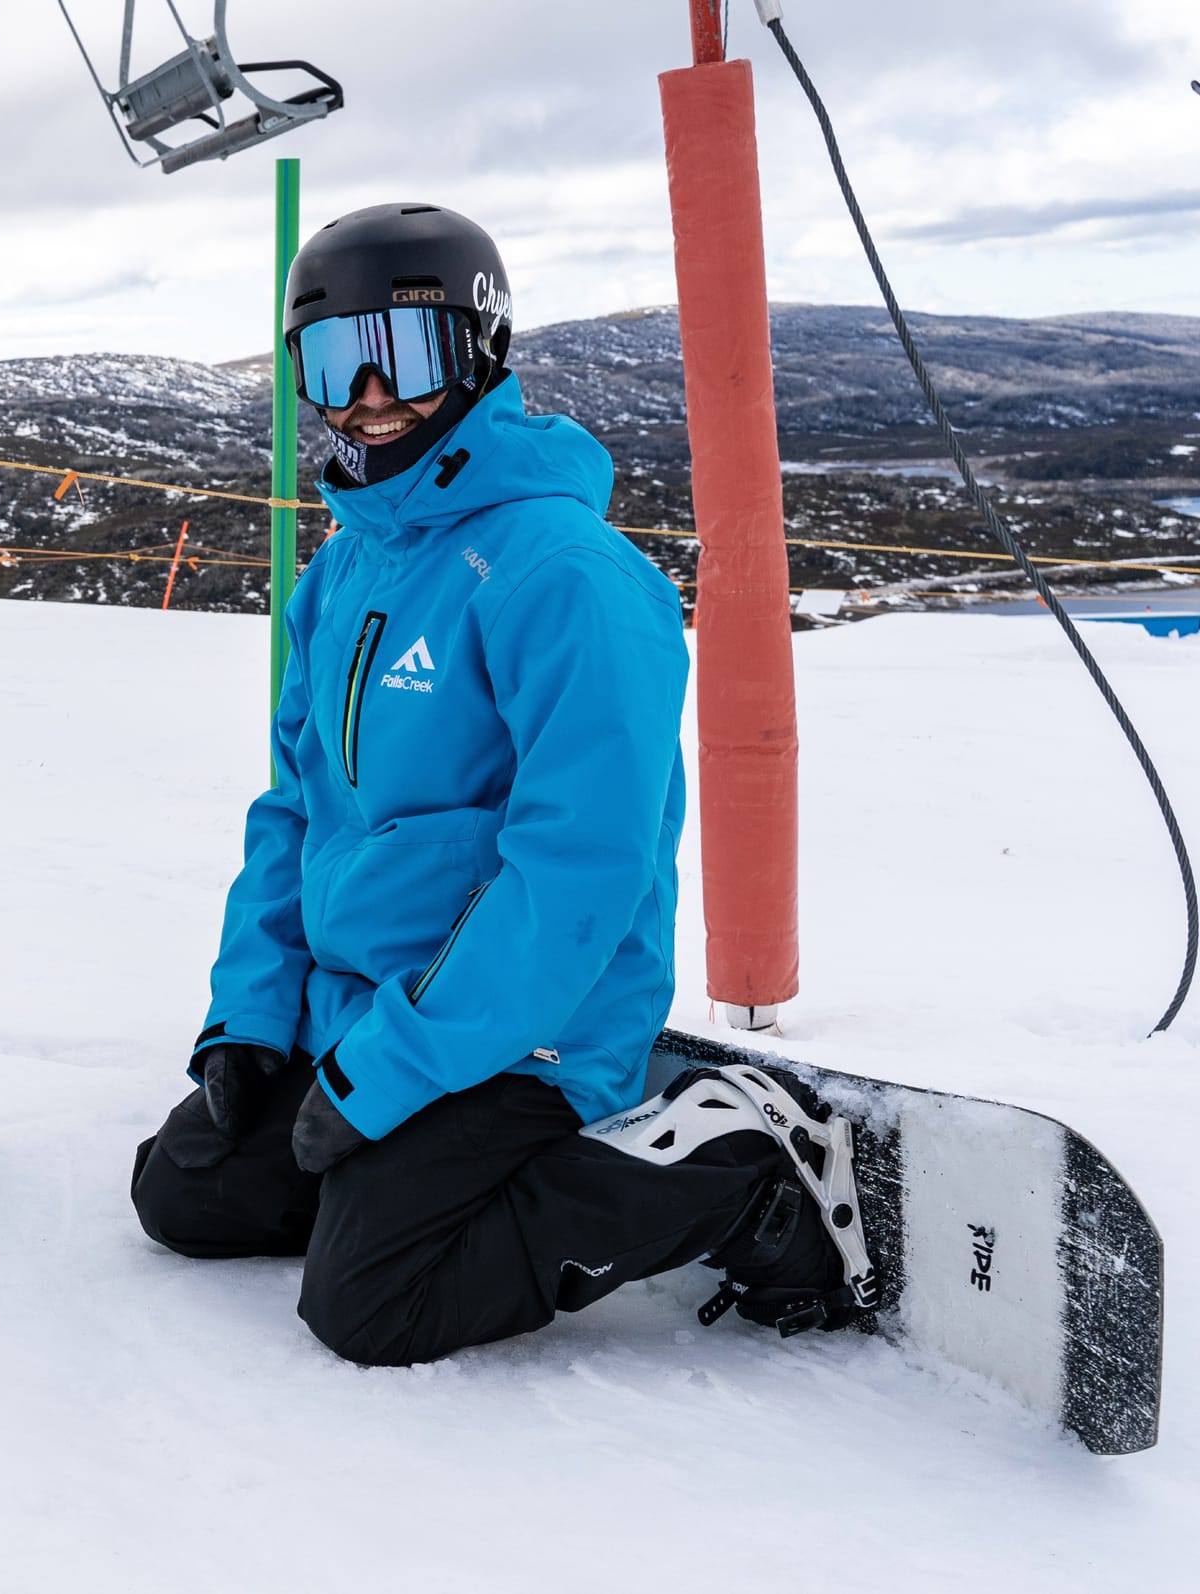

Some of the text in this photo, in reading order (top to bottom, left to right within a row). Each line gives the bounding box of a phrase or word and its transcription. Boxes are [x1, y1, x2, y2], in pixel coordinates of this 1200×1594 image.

[392, 289, 445, 302] GIRO
[465, 328, 473, 359] OAKLEY
[380, 674, 434, 693] FallsCreek
